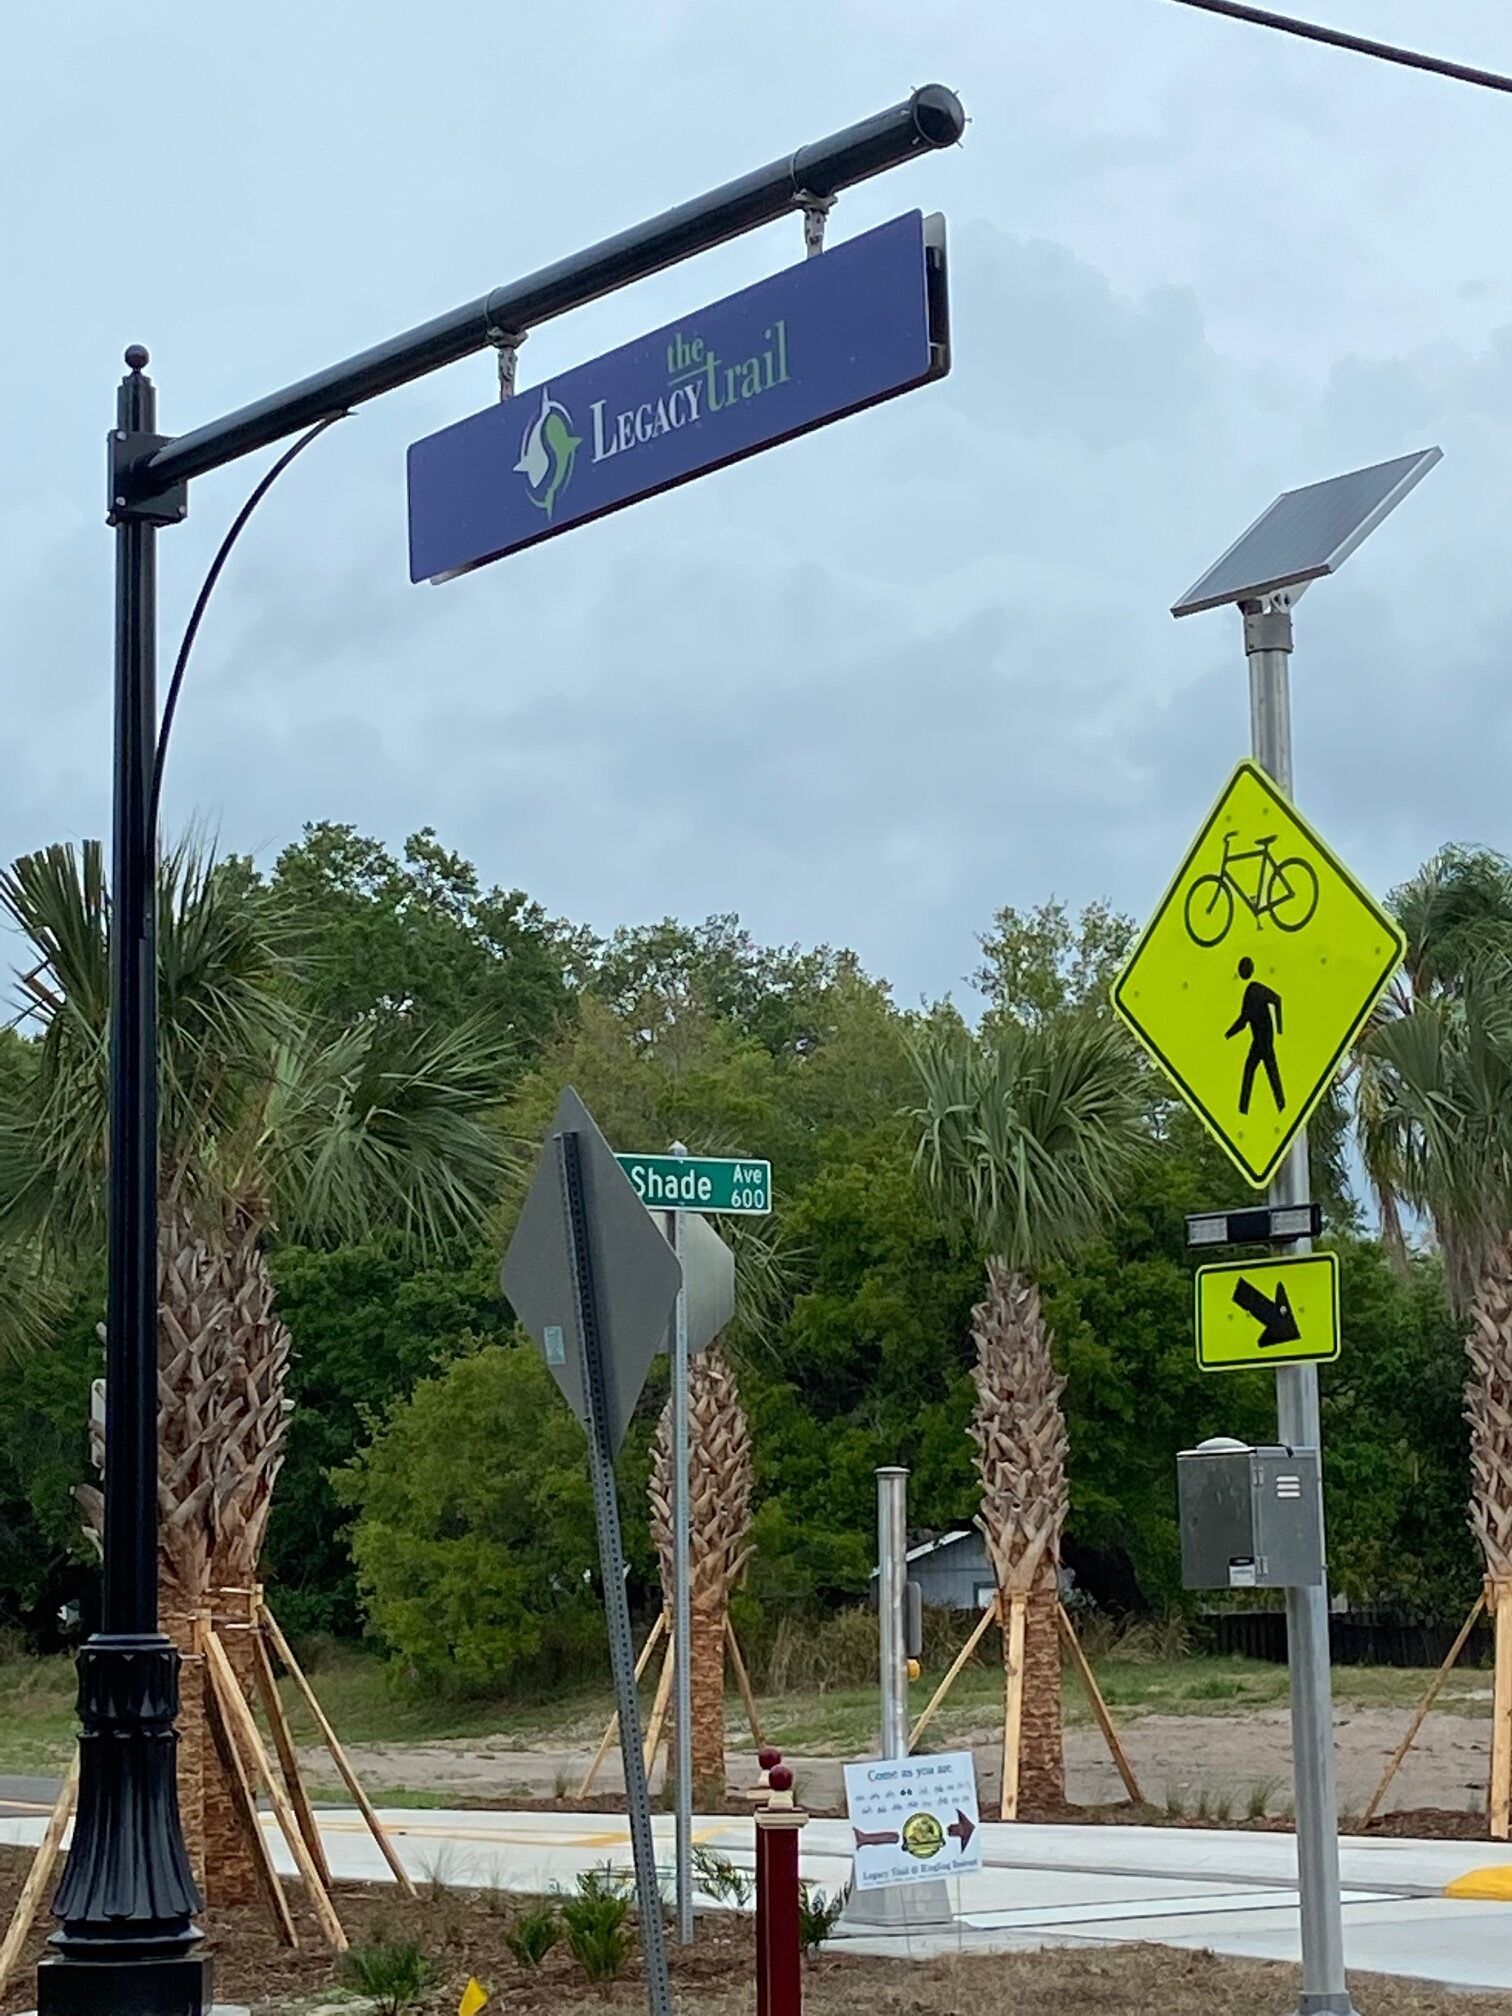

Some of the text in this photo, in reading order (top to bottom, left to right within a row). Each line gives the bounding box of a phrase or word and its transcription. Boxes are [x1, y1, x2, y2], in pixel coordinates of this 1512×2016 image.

[667, 332, 705, 374] the
[706, 320, 791, 413] trail
[631, 1164, 763, 1201] Shade Ave
[731, 1189, 765, 1209] 600
[867, 1769, 898, 1782] Come
[901, 1769, 913, 1778] as
[916, 1766, 935, 1779] you
